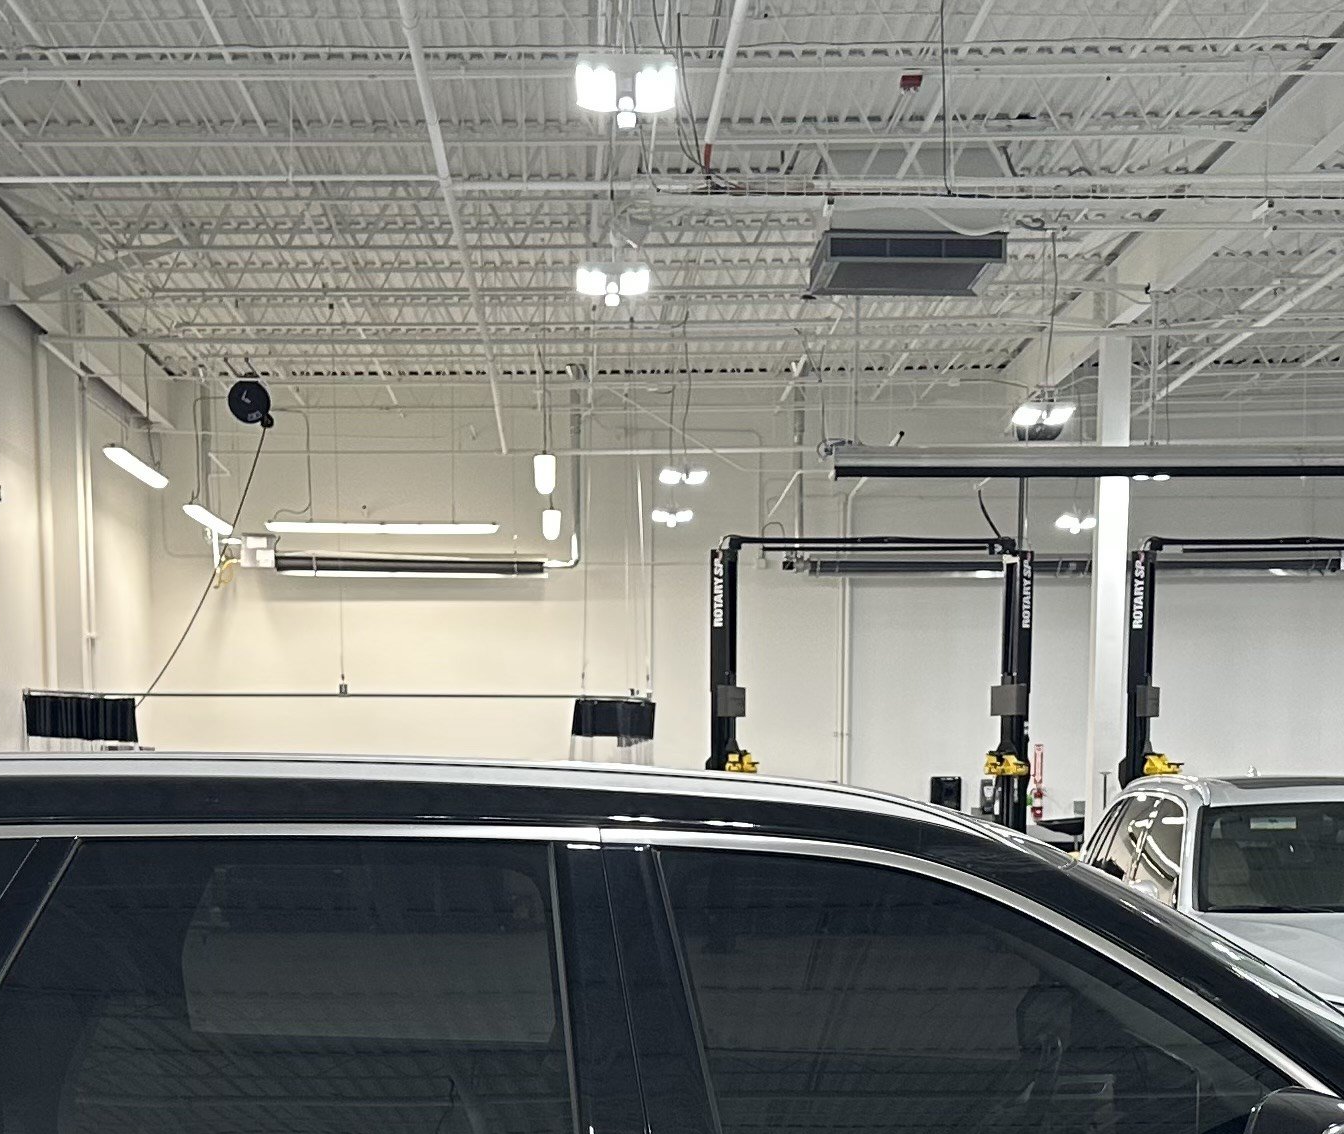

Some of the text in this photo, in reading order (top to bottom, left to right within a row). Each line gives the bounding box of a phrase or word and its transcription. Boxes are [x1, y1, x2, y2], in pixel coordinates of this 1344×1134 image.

[713, 576, 724, 628] ROTARY
[1022, 578, 1032, 629] ROTARY
[1132, 578, 1145, 629] ROTARY
